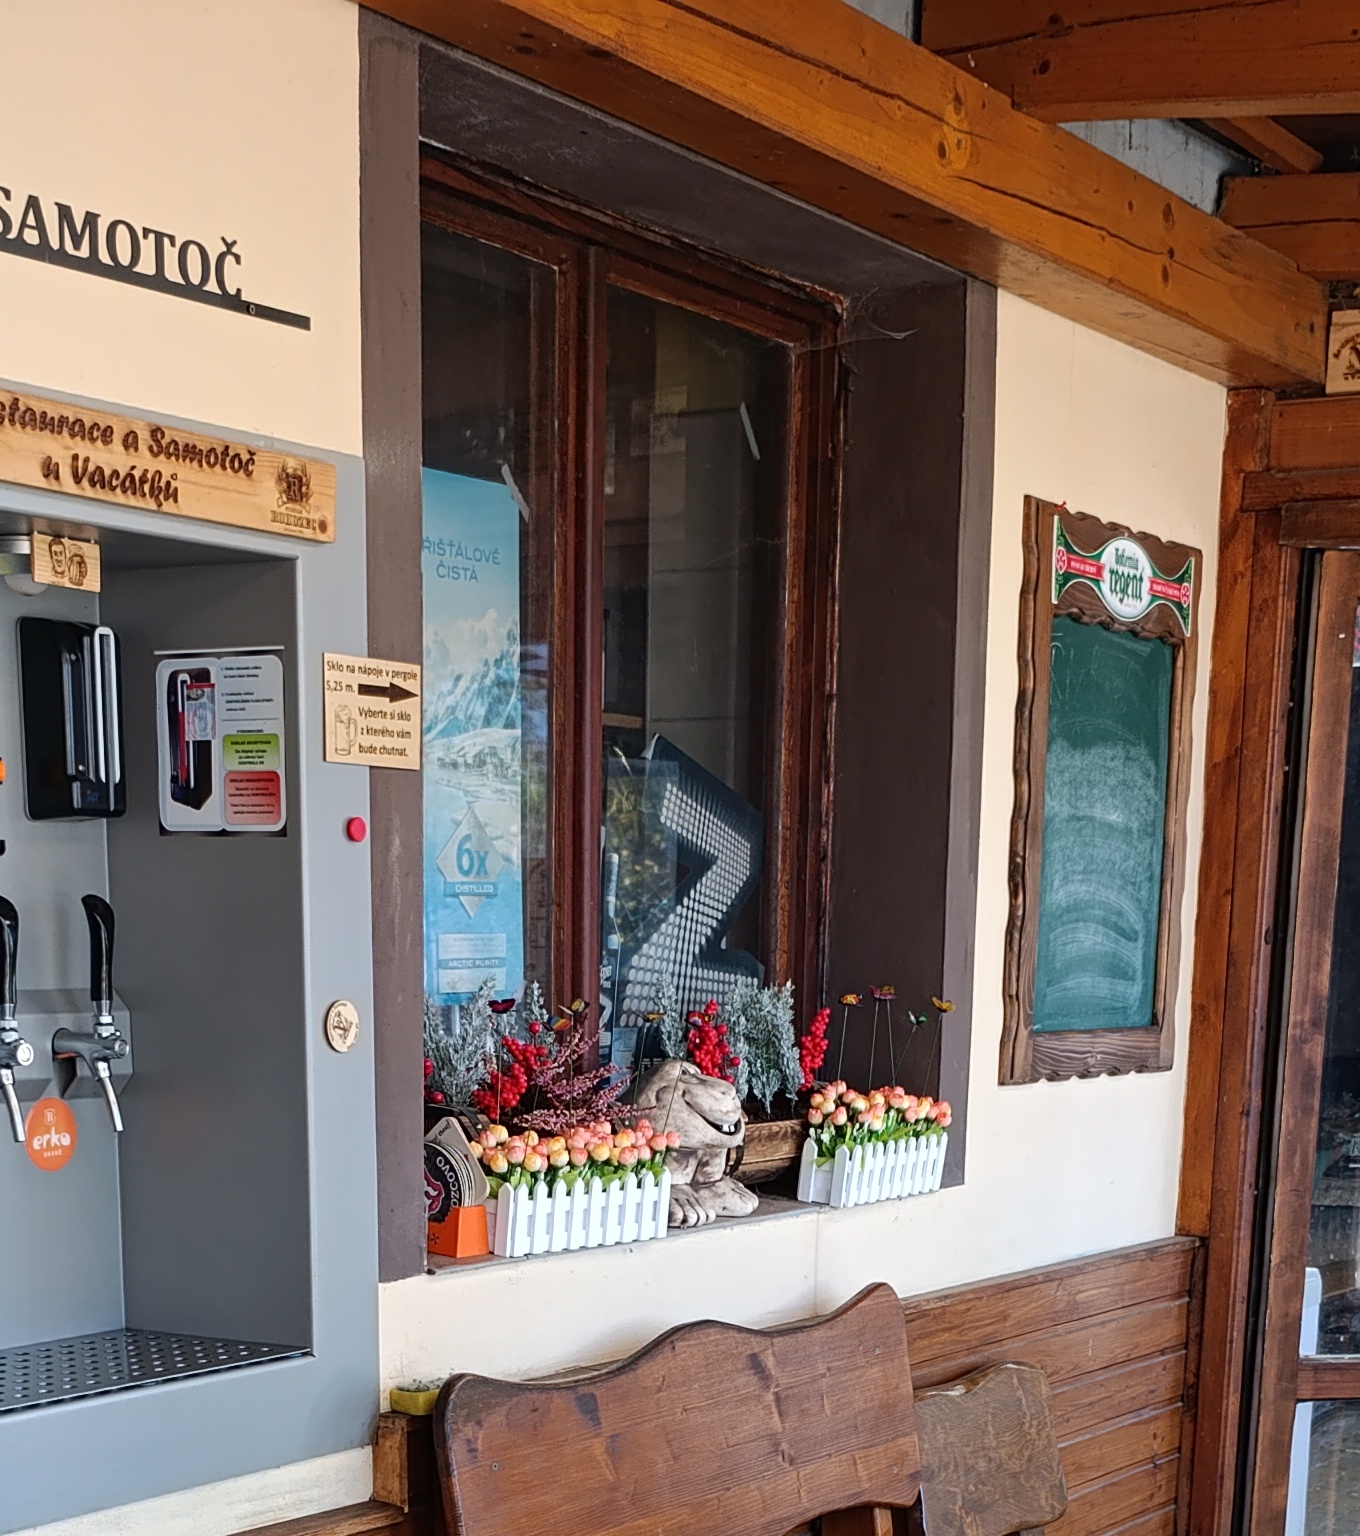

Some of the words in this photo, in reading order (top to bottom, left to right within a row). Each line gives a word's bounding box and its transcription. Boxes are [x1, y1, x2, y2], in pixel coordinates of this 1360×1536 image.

[123, 429, 139, 453] a
[148, 427, 256, 477] Samotoč
[41, 455, 60, 481] u
[71, 453, 180, 509] Vacátků
[436, 560, 480, 583] ČISTÁ
[327, 660, 344, 673] Sklo
[346, 665, 355, 674] na
[358, 664, 383, 679] nápoje
[391, 669, 418, 682] pergole
[326, 680, 343, 693] 5,25
[345, 684, 355, 693] m.
[358, 706, 388, 720] Vyberte
[389, 709, 396, 719] si
[397, 711, 411, 721] sklo
[366, 725, 394, 737] kterého
[396, 729, 411, 739] vám
[358, 742, 378, 754] bude
[379, 744, 408, 757] chutnat.
[455, 833, 489, 879] 6x
[455, 884, 493, 893] DISTILLED
[448, 959, 474, 968] ARCTIC
[476, 959, 500, 967] PURITY
[33, 1126, 71, 1150] erko
